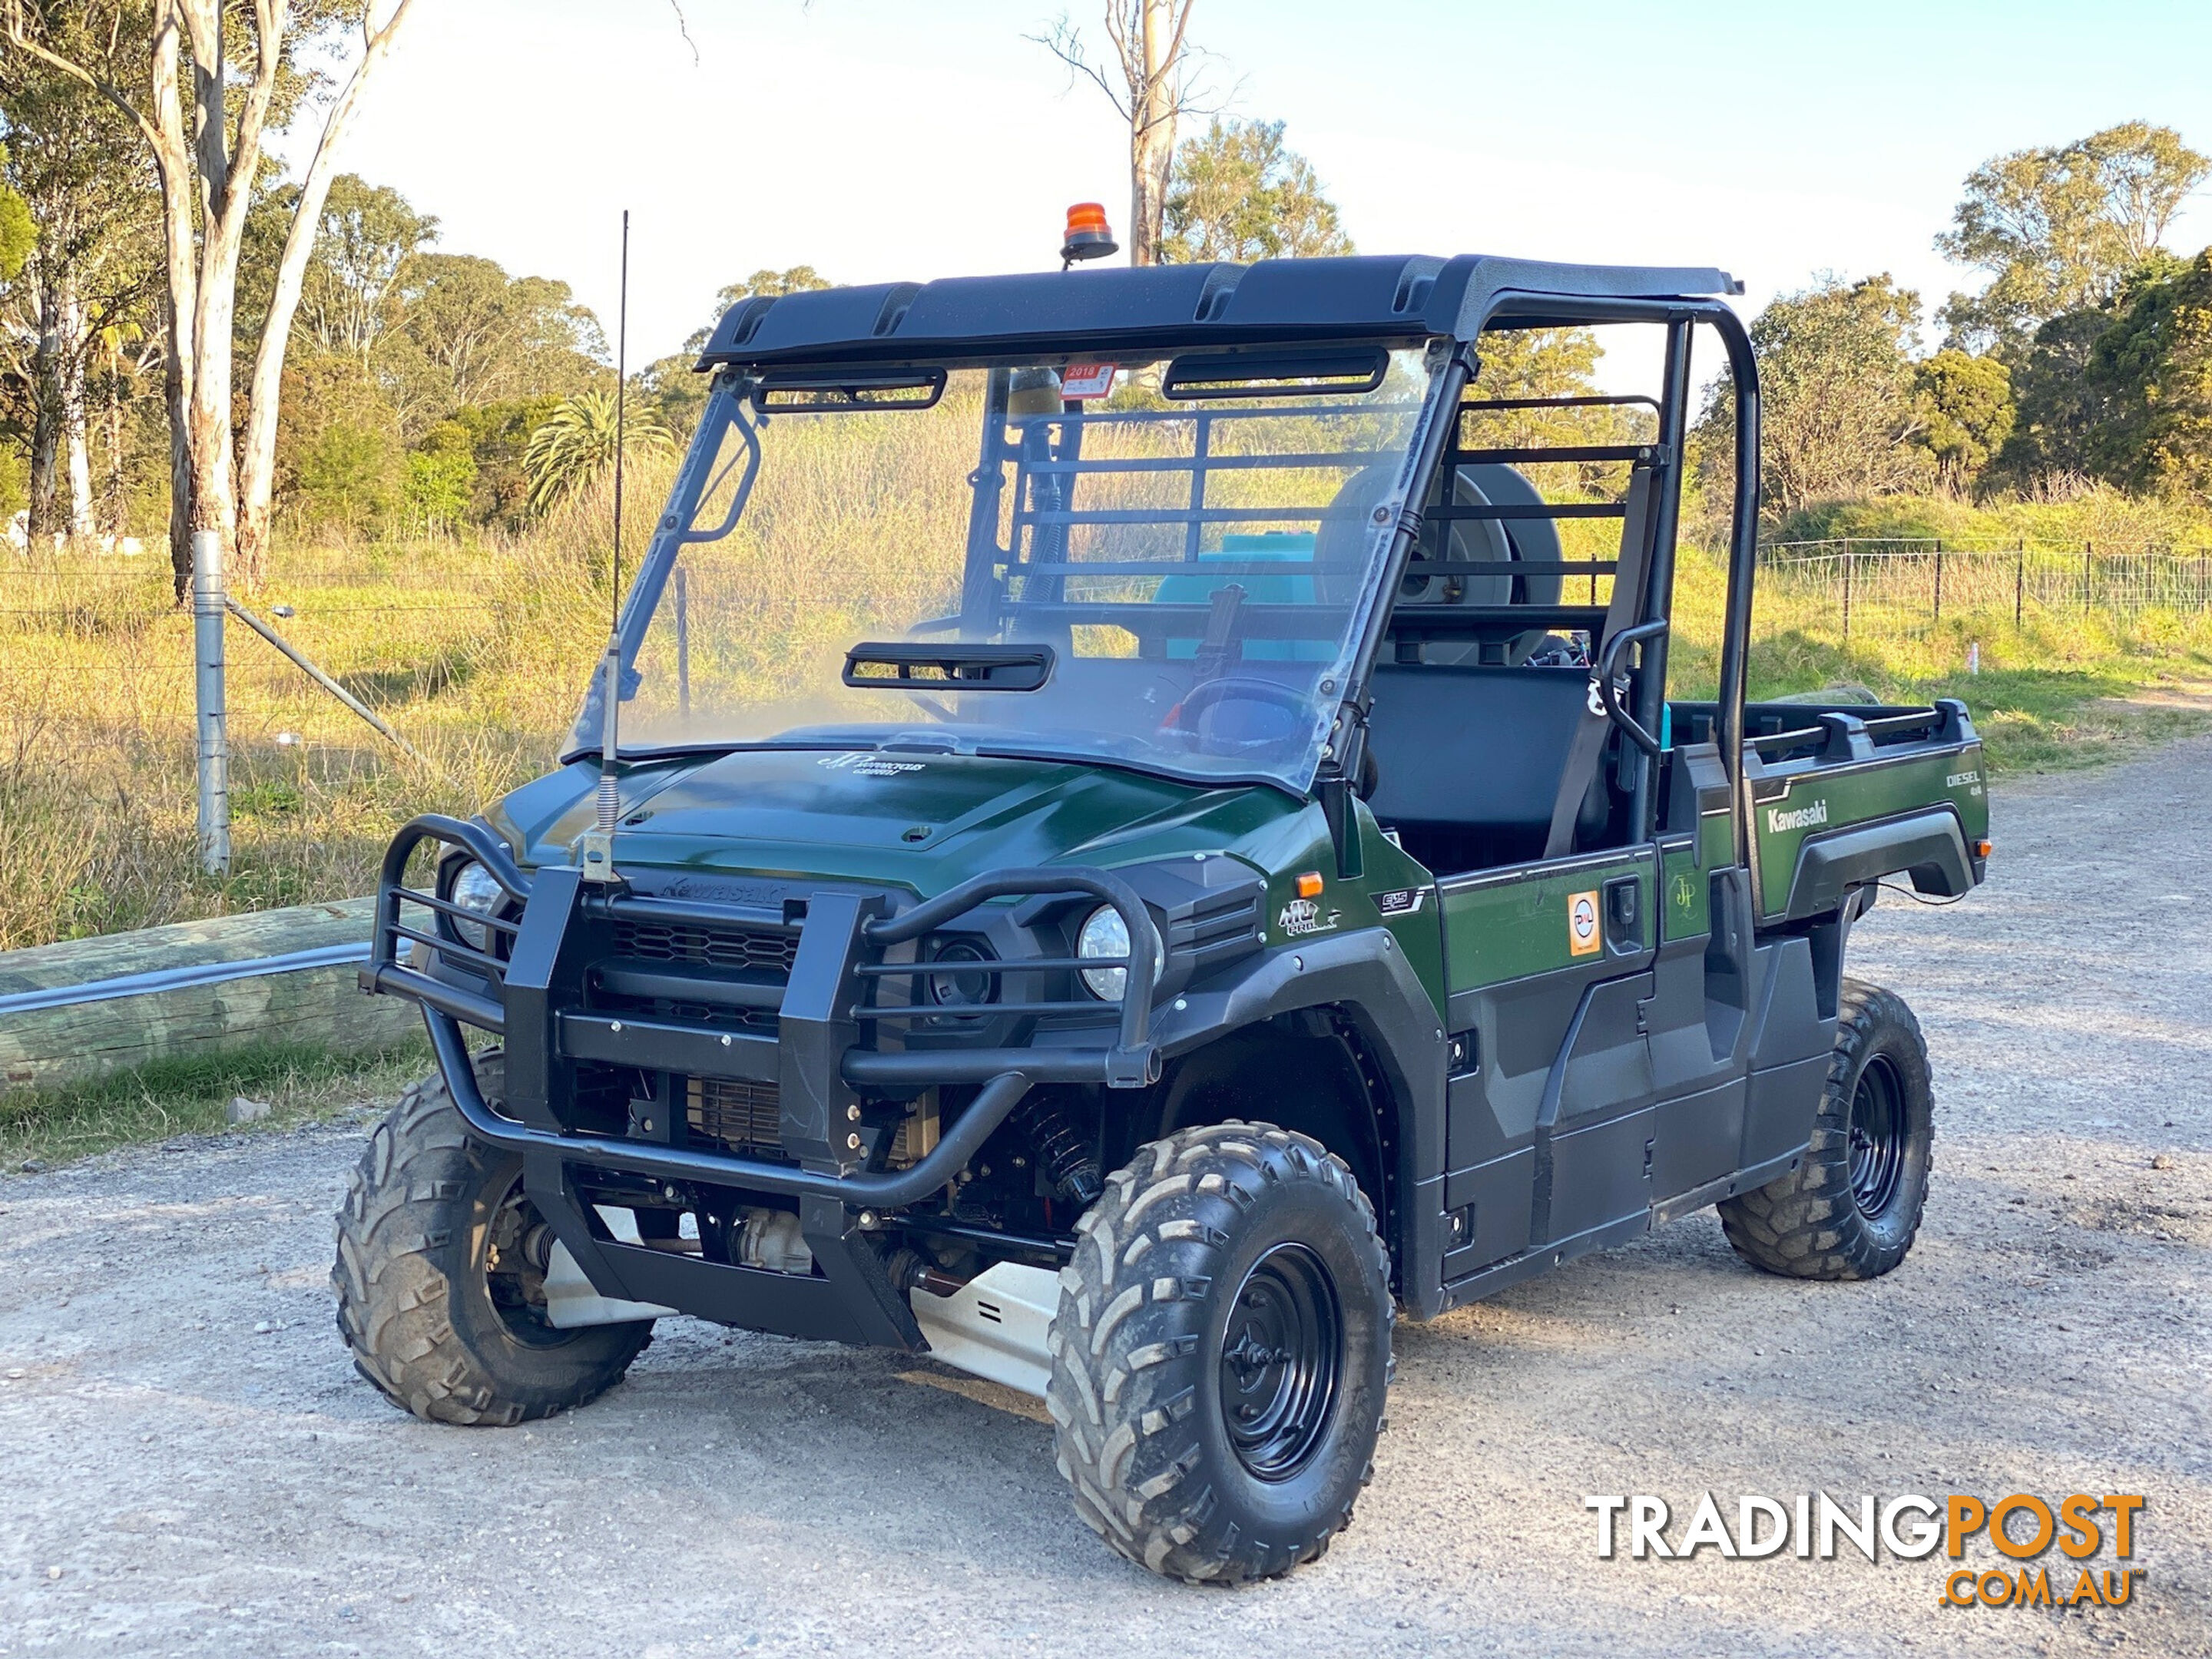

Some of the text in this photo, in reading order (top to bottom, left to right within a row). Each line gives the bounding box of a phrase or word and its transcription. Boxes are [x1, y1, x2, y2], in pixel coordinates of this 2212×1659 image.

[1069, 367, 1095, 376] 2018
[1946, 770, 1981, 788] DIESEL
[1768, 799, 1827, 833] Kawasaki
[660, 877, 789, 905] Kawasaki
